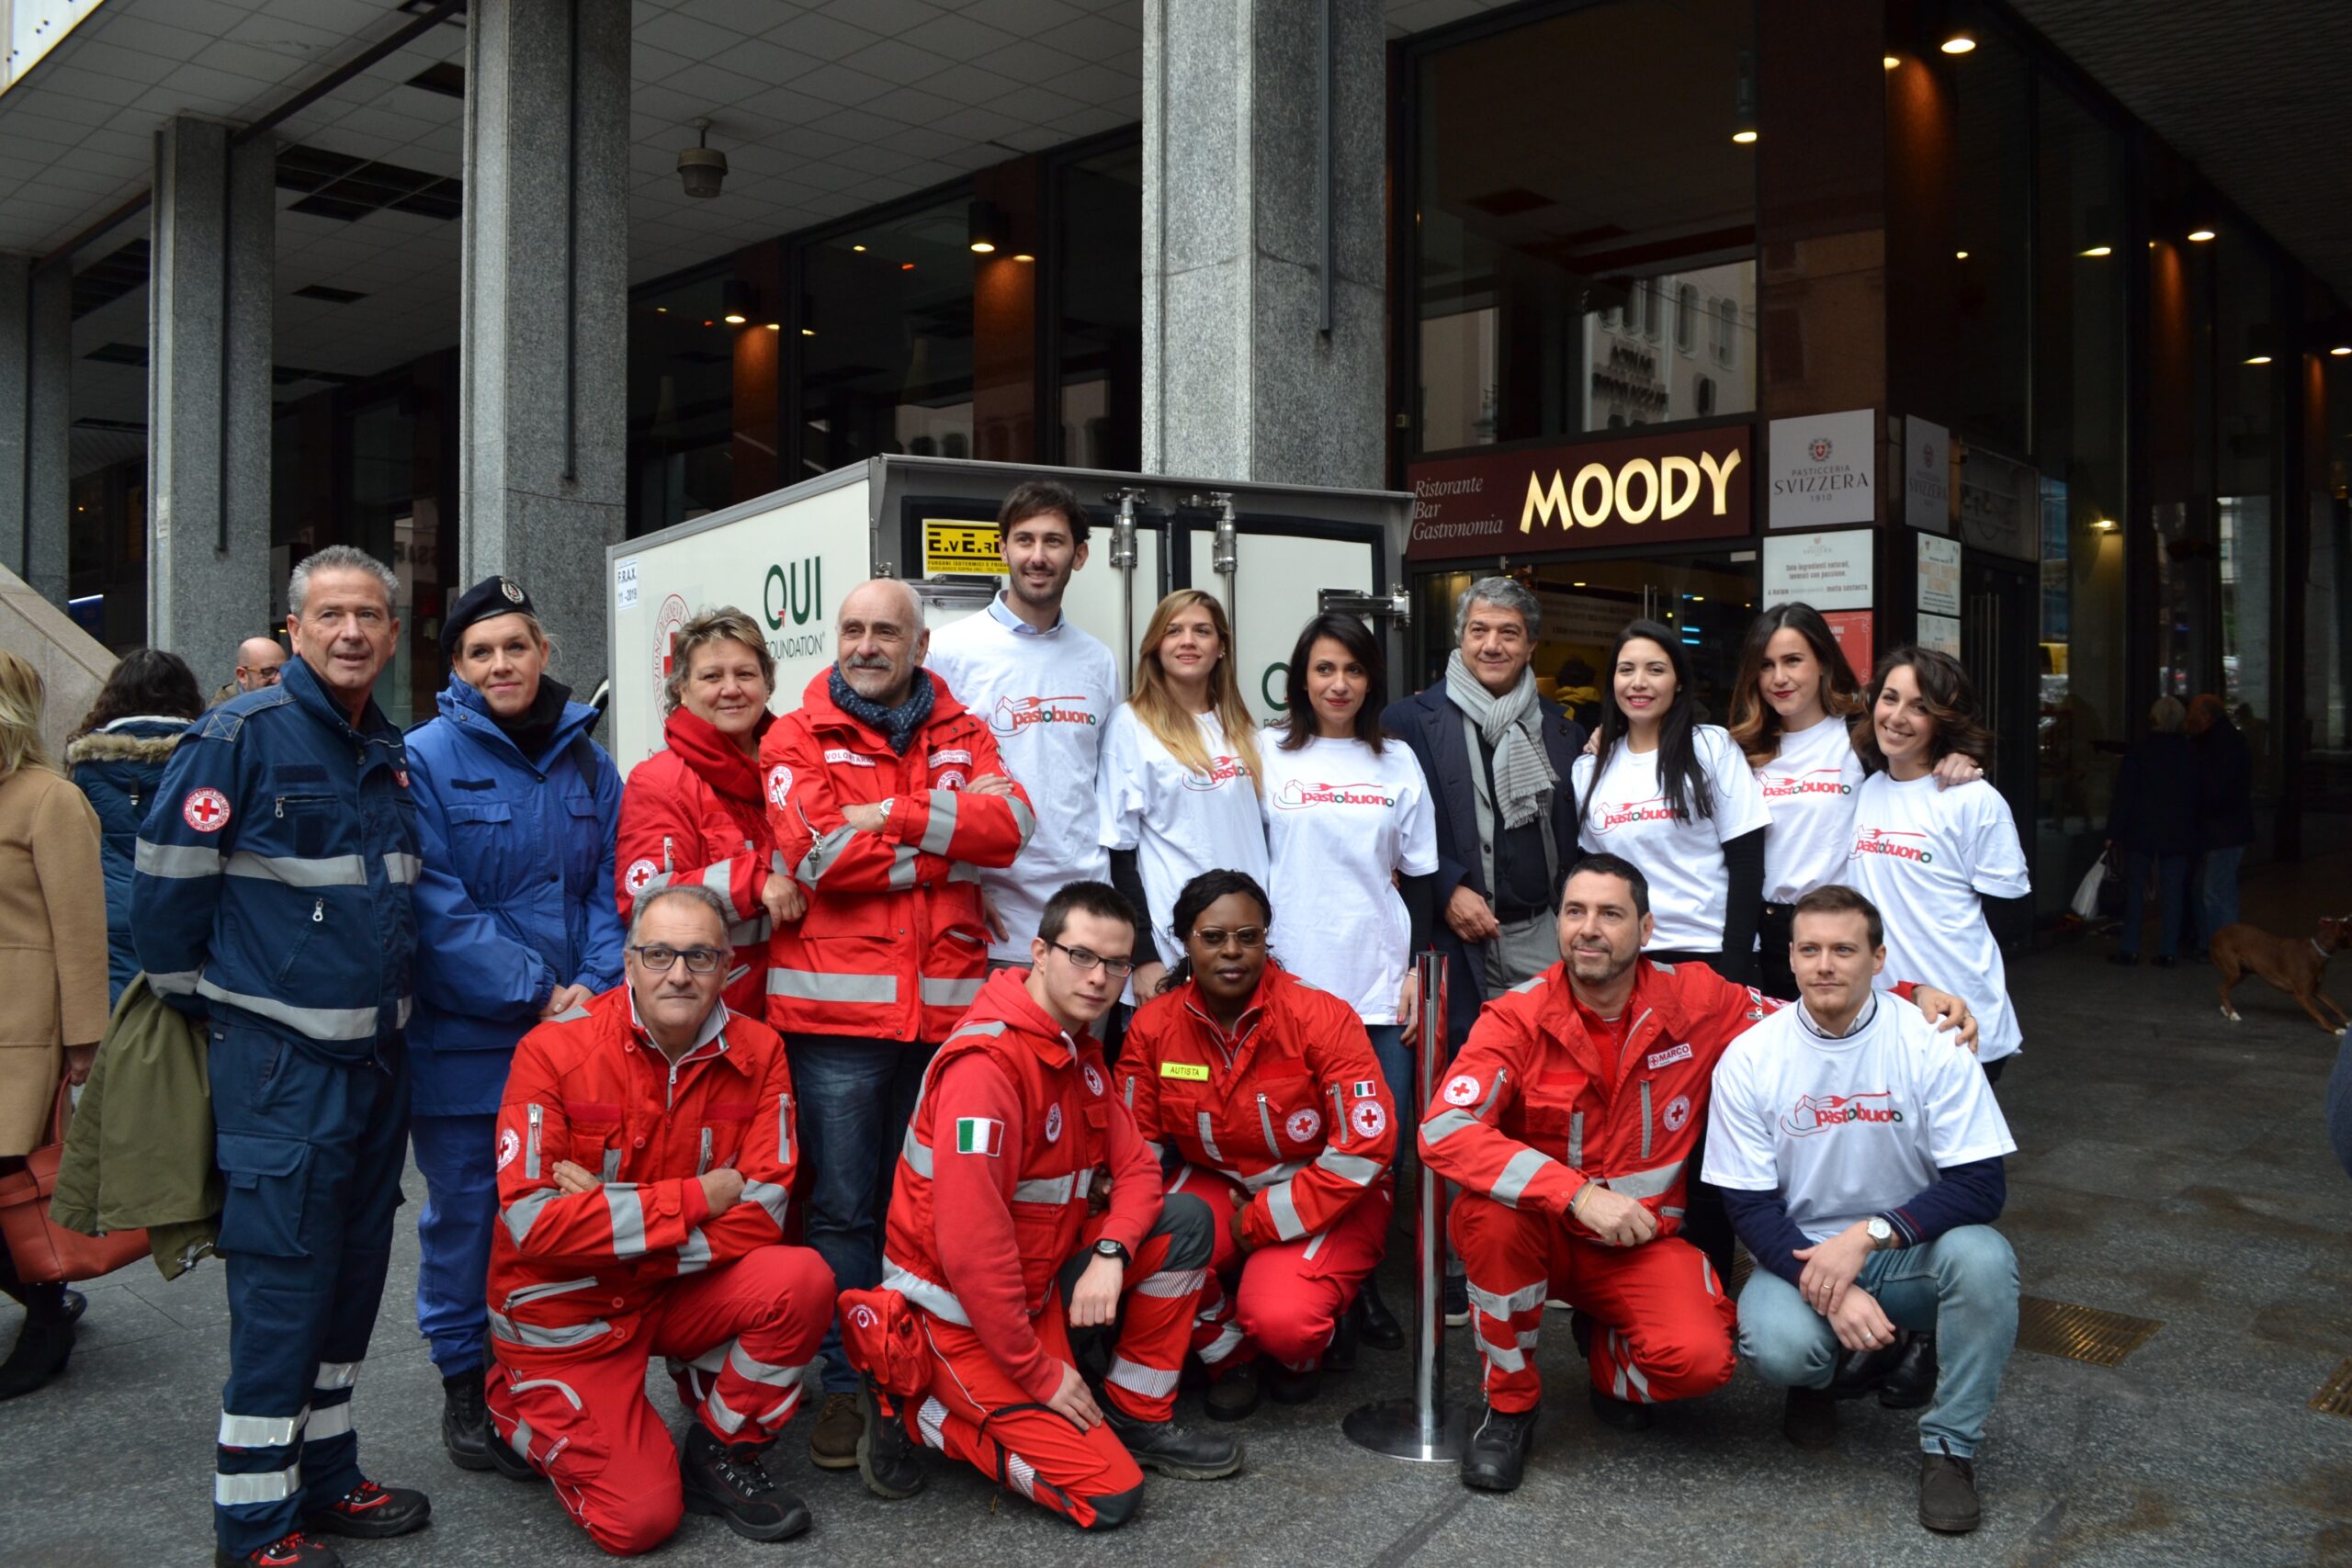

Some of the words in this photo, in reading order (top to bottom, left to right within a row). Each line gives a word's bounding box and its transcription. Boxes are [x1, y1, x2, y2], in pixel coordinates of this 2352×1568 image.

[1792, 465, 1850, 477] PASTICCERIA
[1415, 476, 1484, 498] Ristorante
[1519, 448, 1741, 535] MOODY
[1774, 472, 1869, 495] SVIZZERA
[1414, 501, 1442, 520] Bar
[1412, 513, 1503, 541] Gastronomia
[763, 555, 821, 631] QUI
[1012, 705, 1096, 730] pastobuono
[1301, 791, 1395, 807] pastobuono
[1763, 780, 1851, 797] pastobuono
[1856, 838, 1933, 863] pastobuono
[1658, 1045, 1690, 1063] MARCO
[1170, 1066, 1200, 1076] AUTISTA
